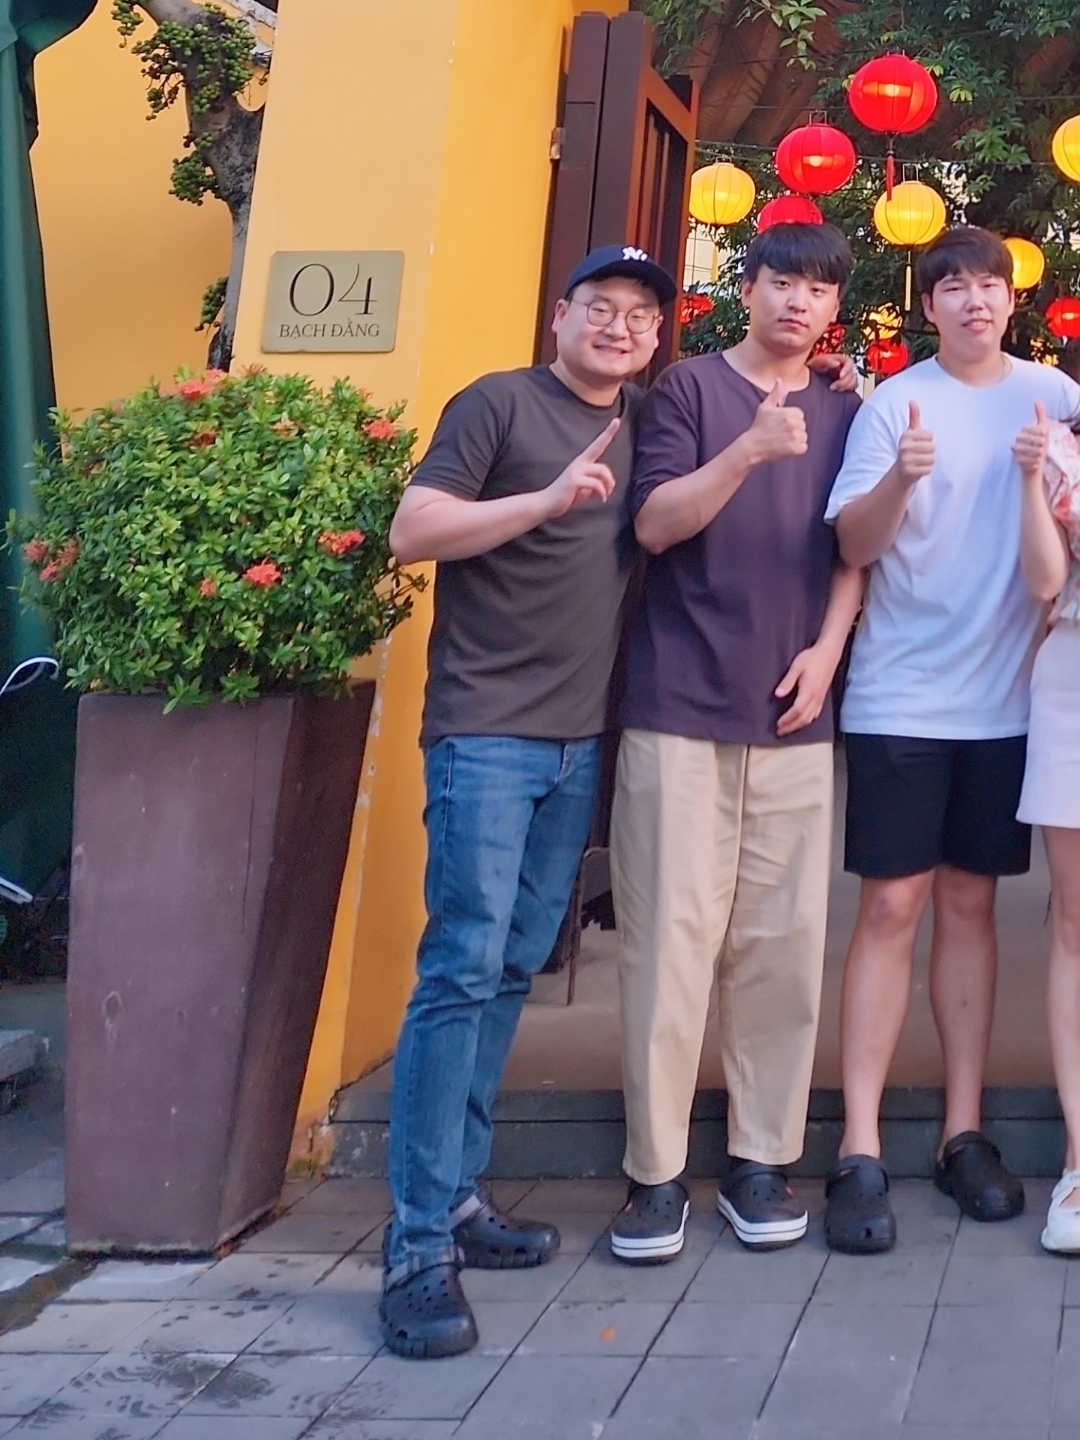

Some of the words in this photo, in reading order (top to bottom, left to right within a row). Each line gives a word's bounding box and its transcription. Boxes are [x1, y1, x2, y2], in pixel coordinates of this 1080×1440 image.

[290, 263, 378, 316] 04
[279, 322, 327, 339] BẠCH
[331, 317, 380, 338] ĐẰNG
